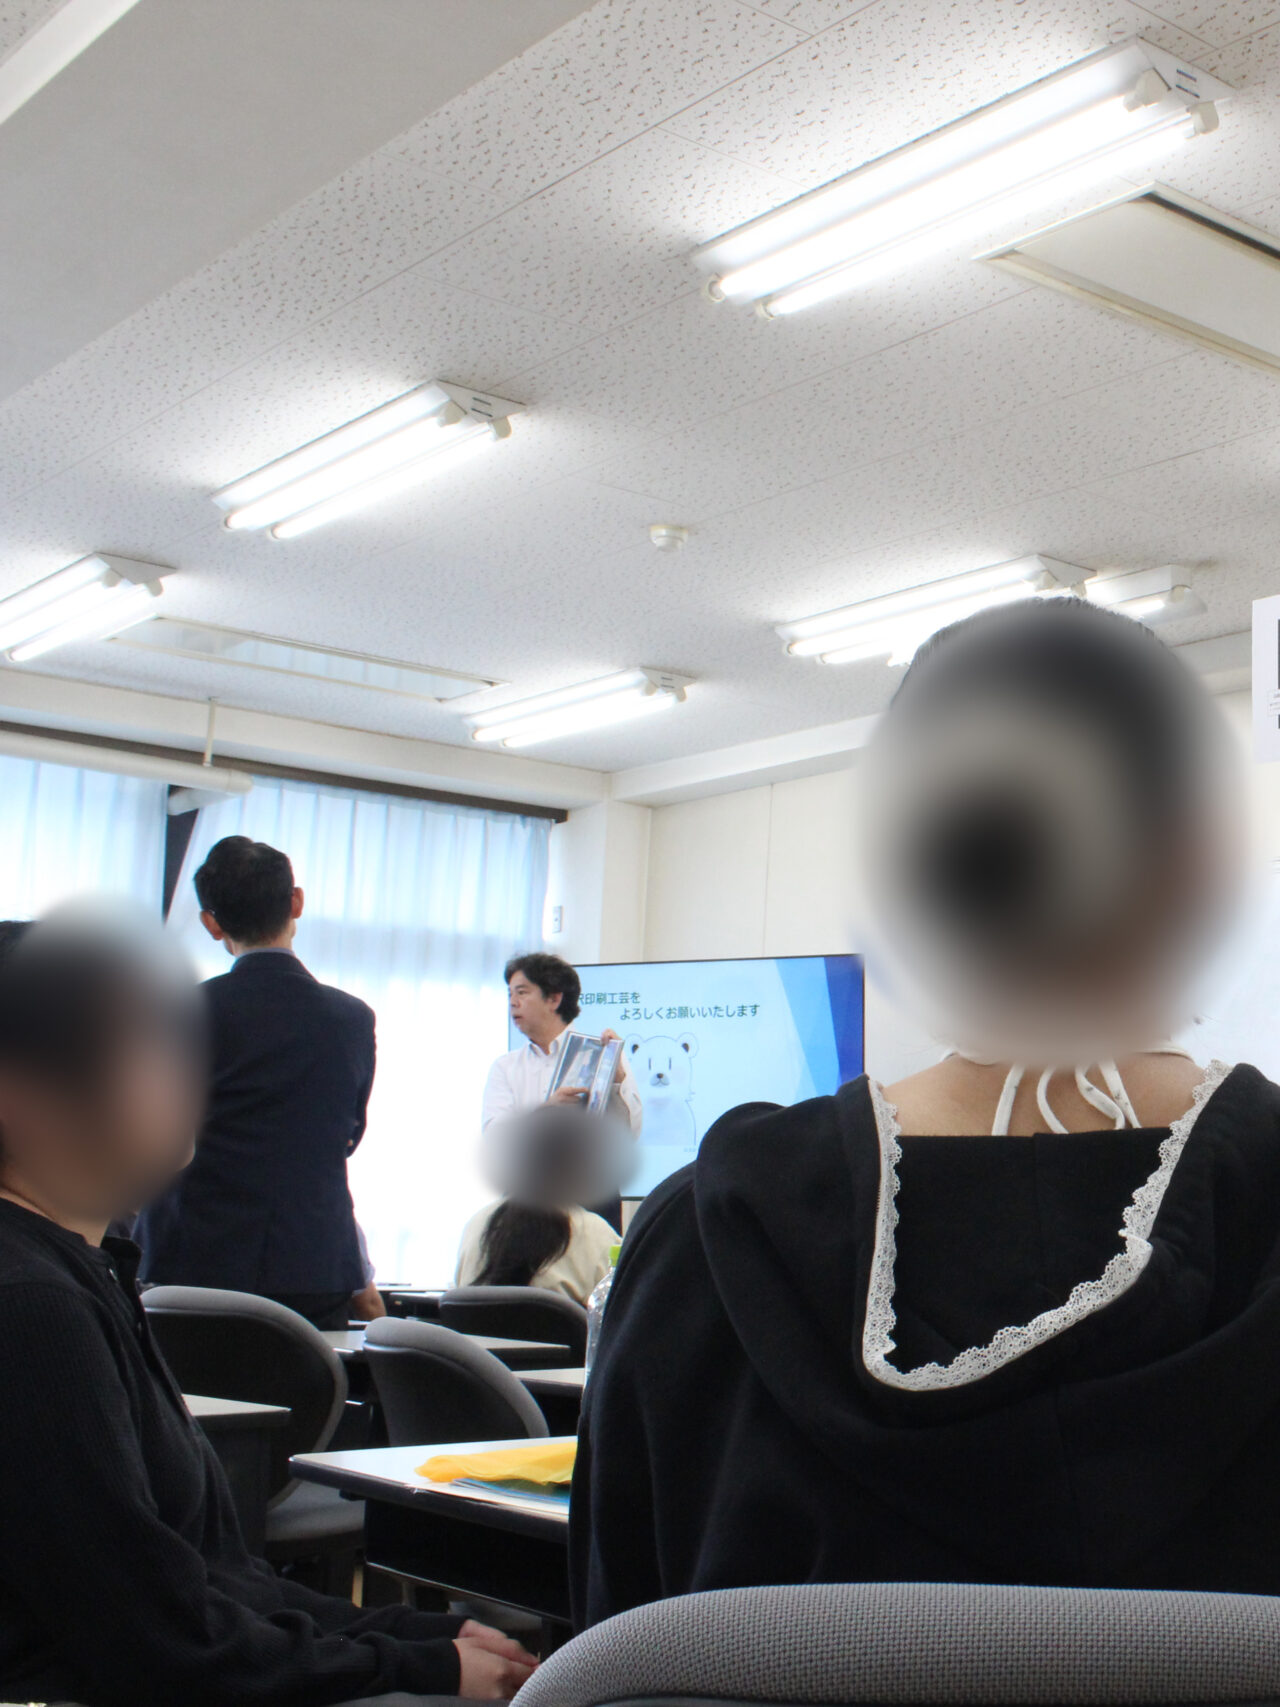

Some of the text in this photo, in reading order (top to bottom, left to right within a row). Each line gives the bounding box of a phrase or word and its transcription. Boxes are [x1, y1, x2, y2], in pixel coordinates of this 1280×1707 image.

[619, 1003, 761, 1021] よろしくお願いいたします
